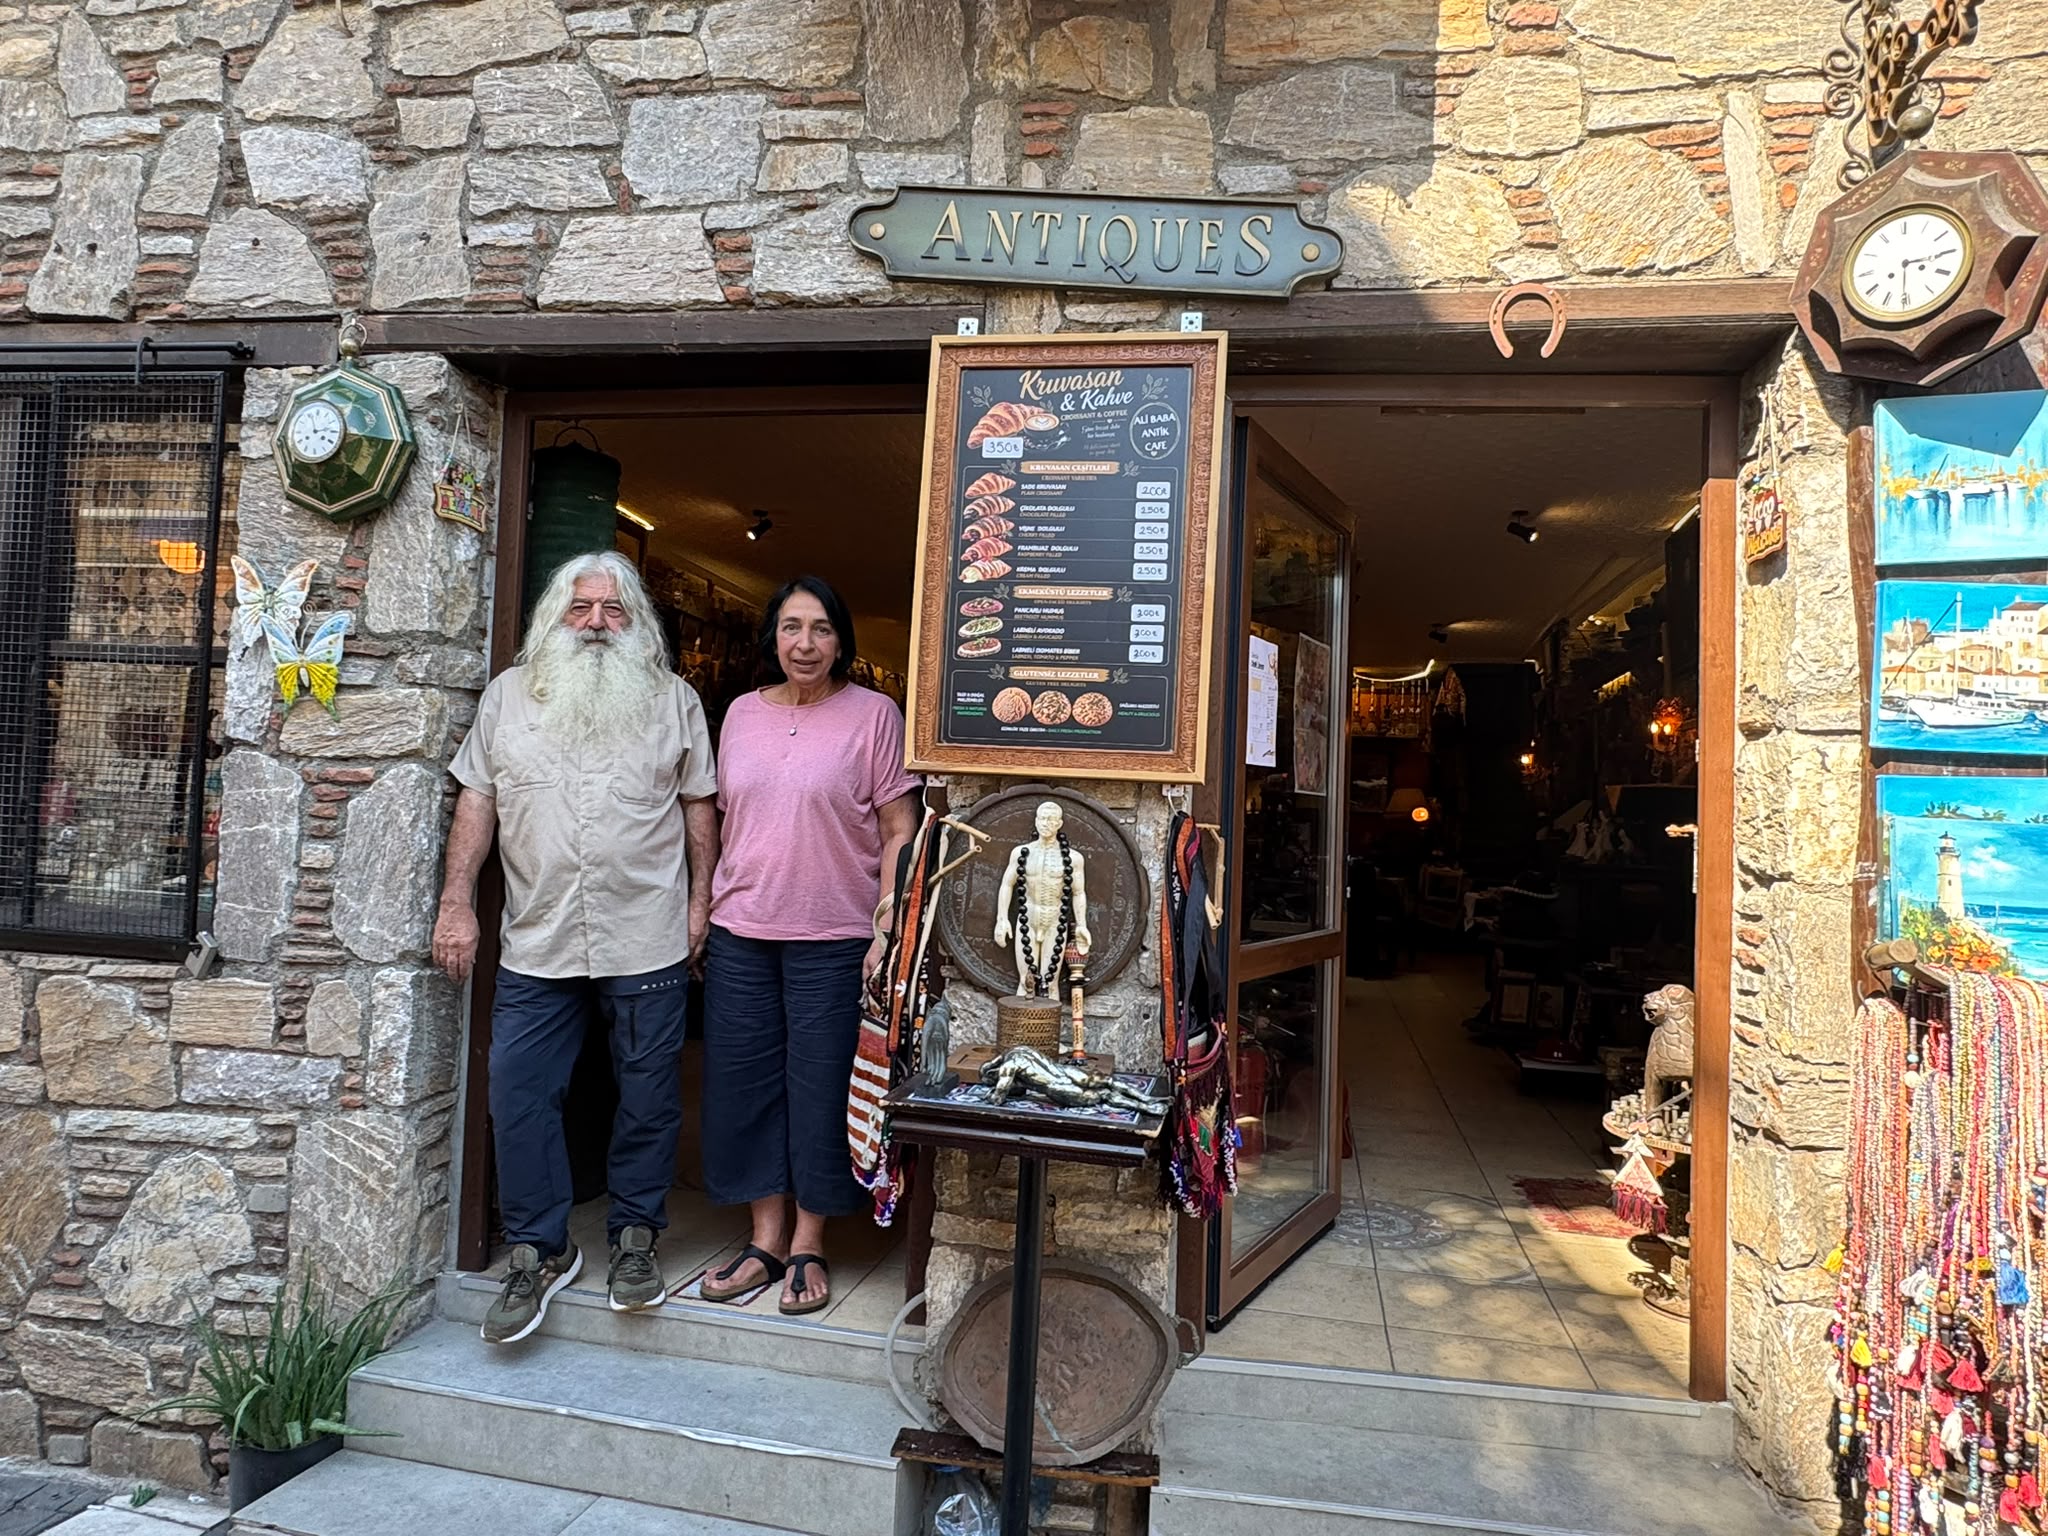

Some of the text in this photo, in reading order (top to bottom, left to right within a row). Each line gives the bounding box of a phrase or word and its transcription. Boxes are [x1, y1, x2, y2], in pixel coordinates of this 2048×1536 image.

[920, 200, 1273, 284] ANTIQUES
[1019, 369, 1124, 400] Kruvasan
[1060, 386, 1134, 411] & Kahve
[1103, 409, 1128, 418] COFFEE
[1134, 412, 1176, 425] ALİ BABA
[1141, 427, 1169, 438] ANTİK
[1144, 440, 1167, 451] CAFE
[1013, 669, 1099, 679] GLUTENSİZ LEZZETLER
